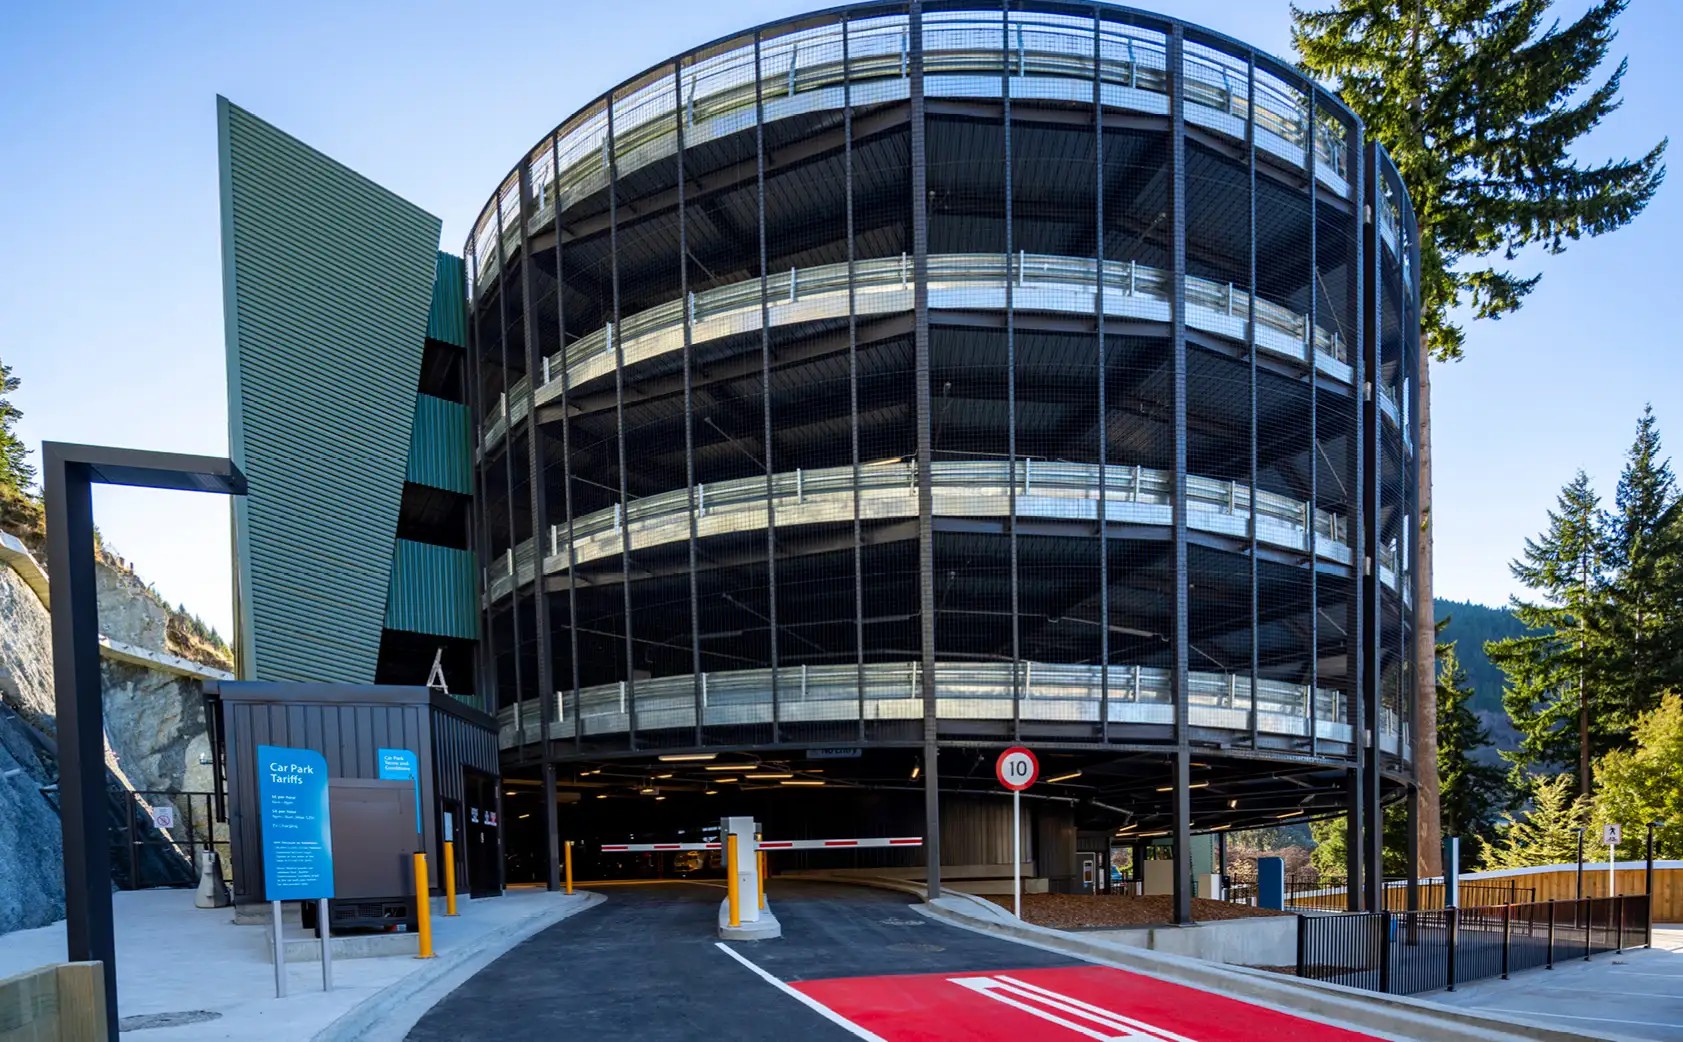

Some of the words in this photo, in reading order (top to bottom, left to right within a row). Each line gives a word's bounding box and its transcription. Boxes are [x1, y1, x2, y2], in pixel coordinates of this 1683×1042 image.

[269, 762, 288, 772] Car
[290, 763, 314, 774] Park
[1008, 760, 1027, 776] 10
[270, 773, 303, 785] Tariffs
